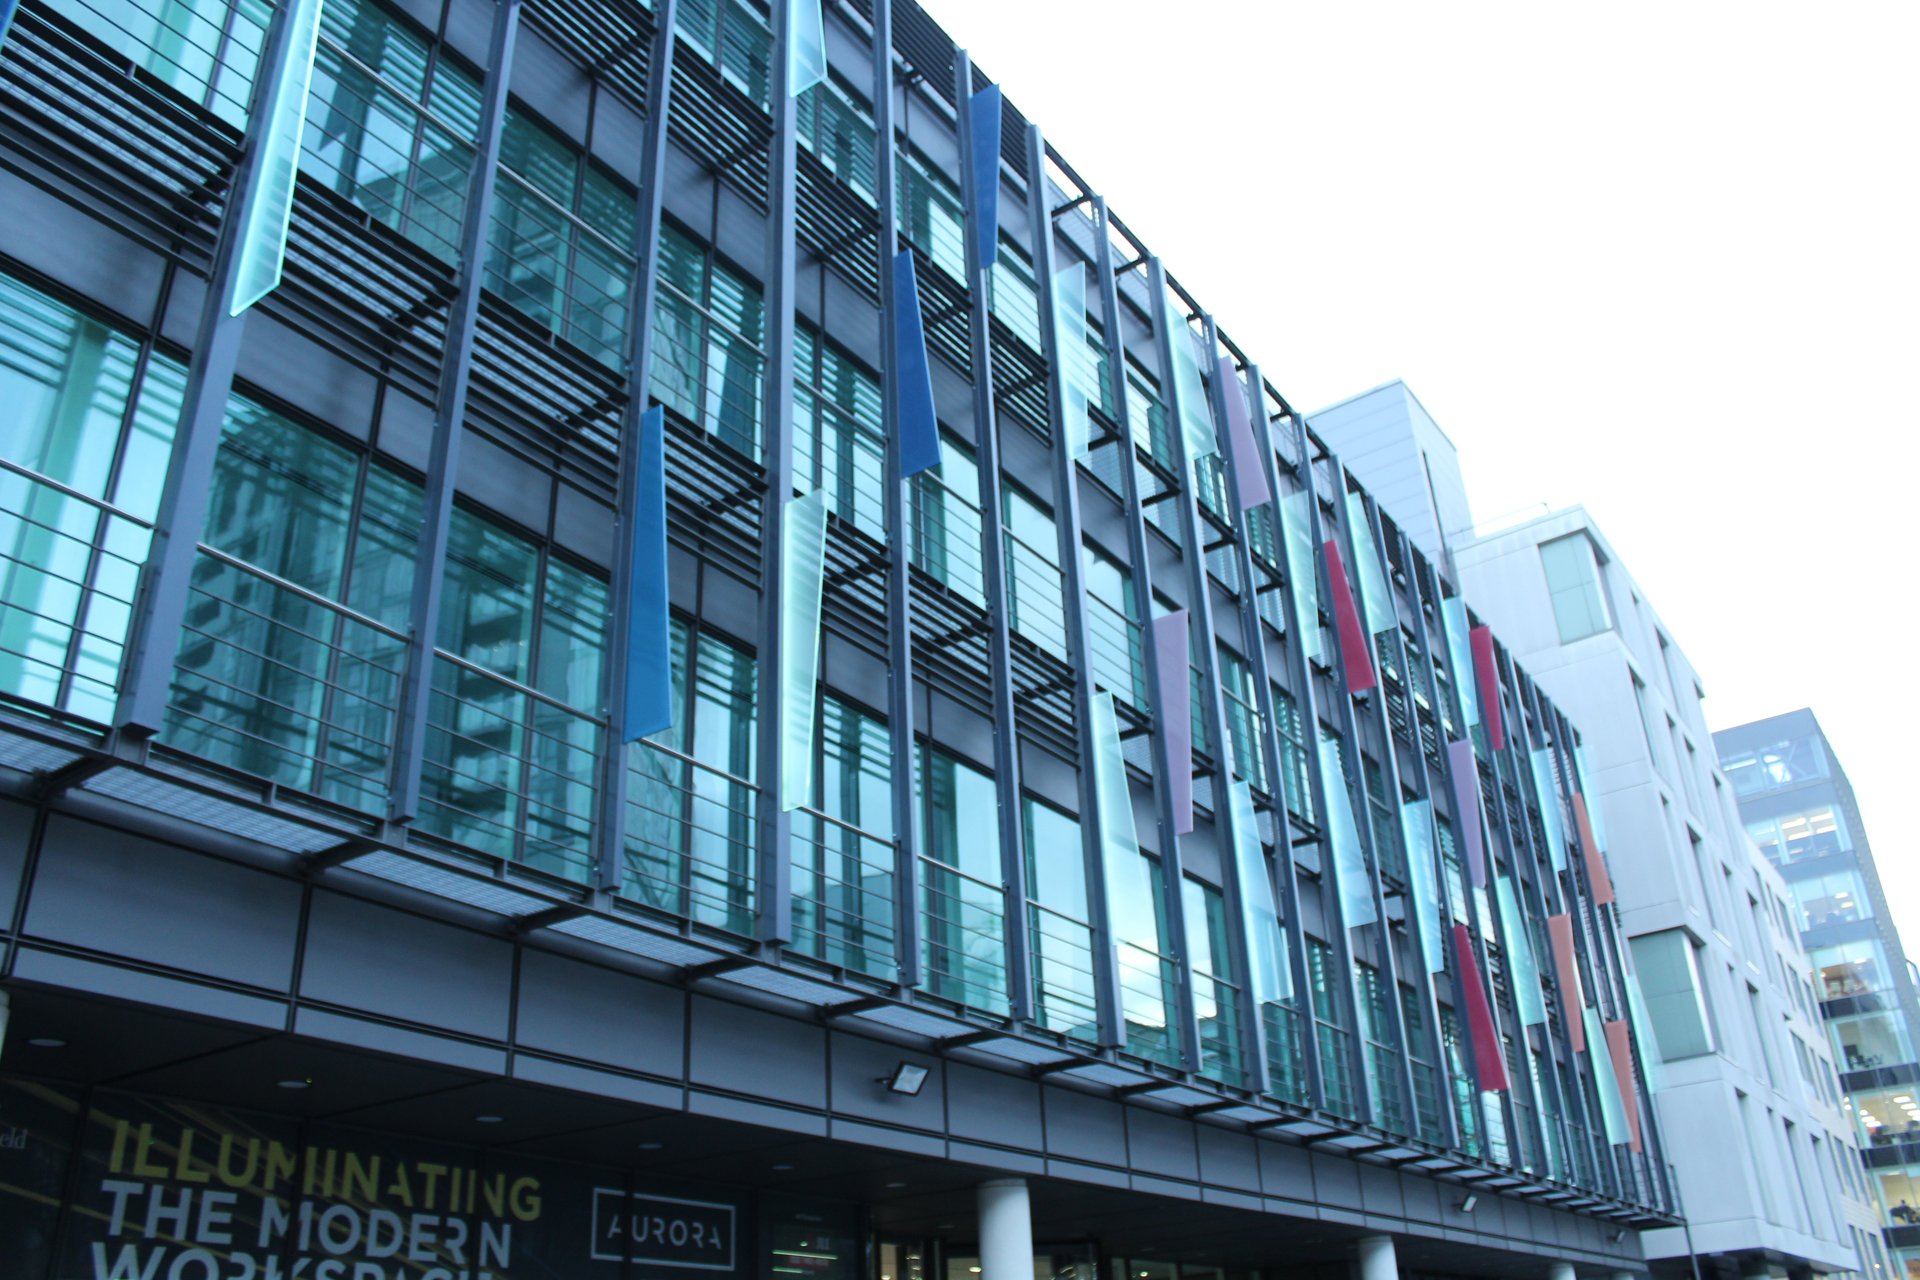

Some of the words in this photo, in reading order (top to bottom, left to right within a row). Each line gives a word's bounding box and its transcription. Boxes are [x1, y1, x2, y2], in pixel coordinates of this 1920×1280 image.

[109, 1119, 542, 1222] ILLUMINATING
[101, 1179, 238, 1244] THE
[258, 1197, 511, 1269] MODERN
[607, 1214, 722, 1250] AURORA
